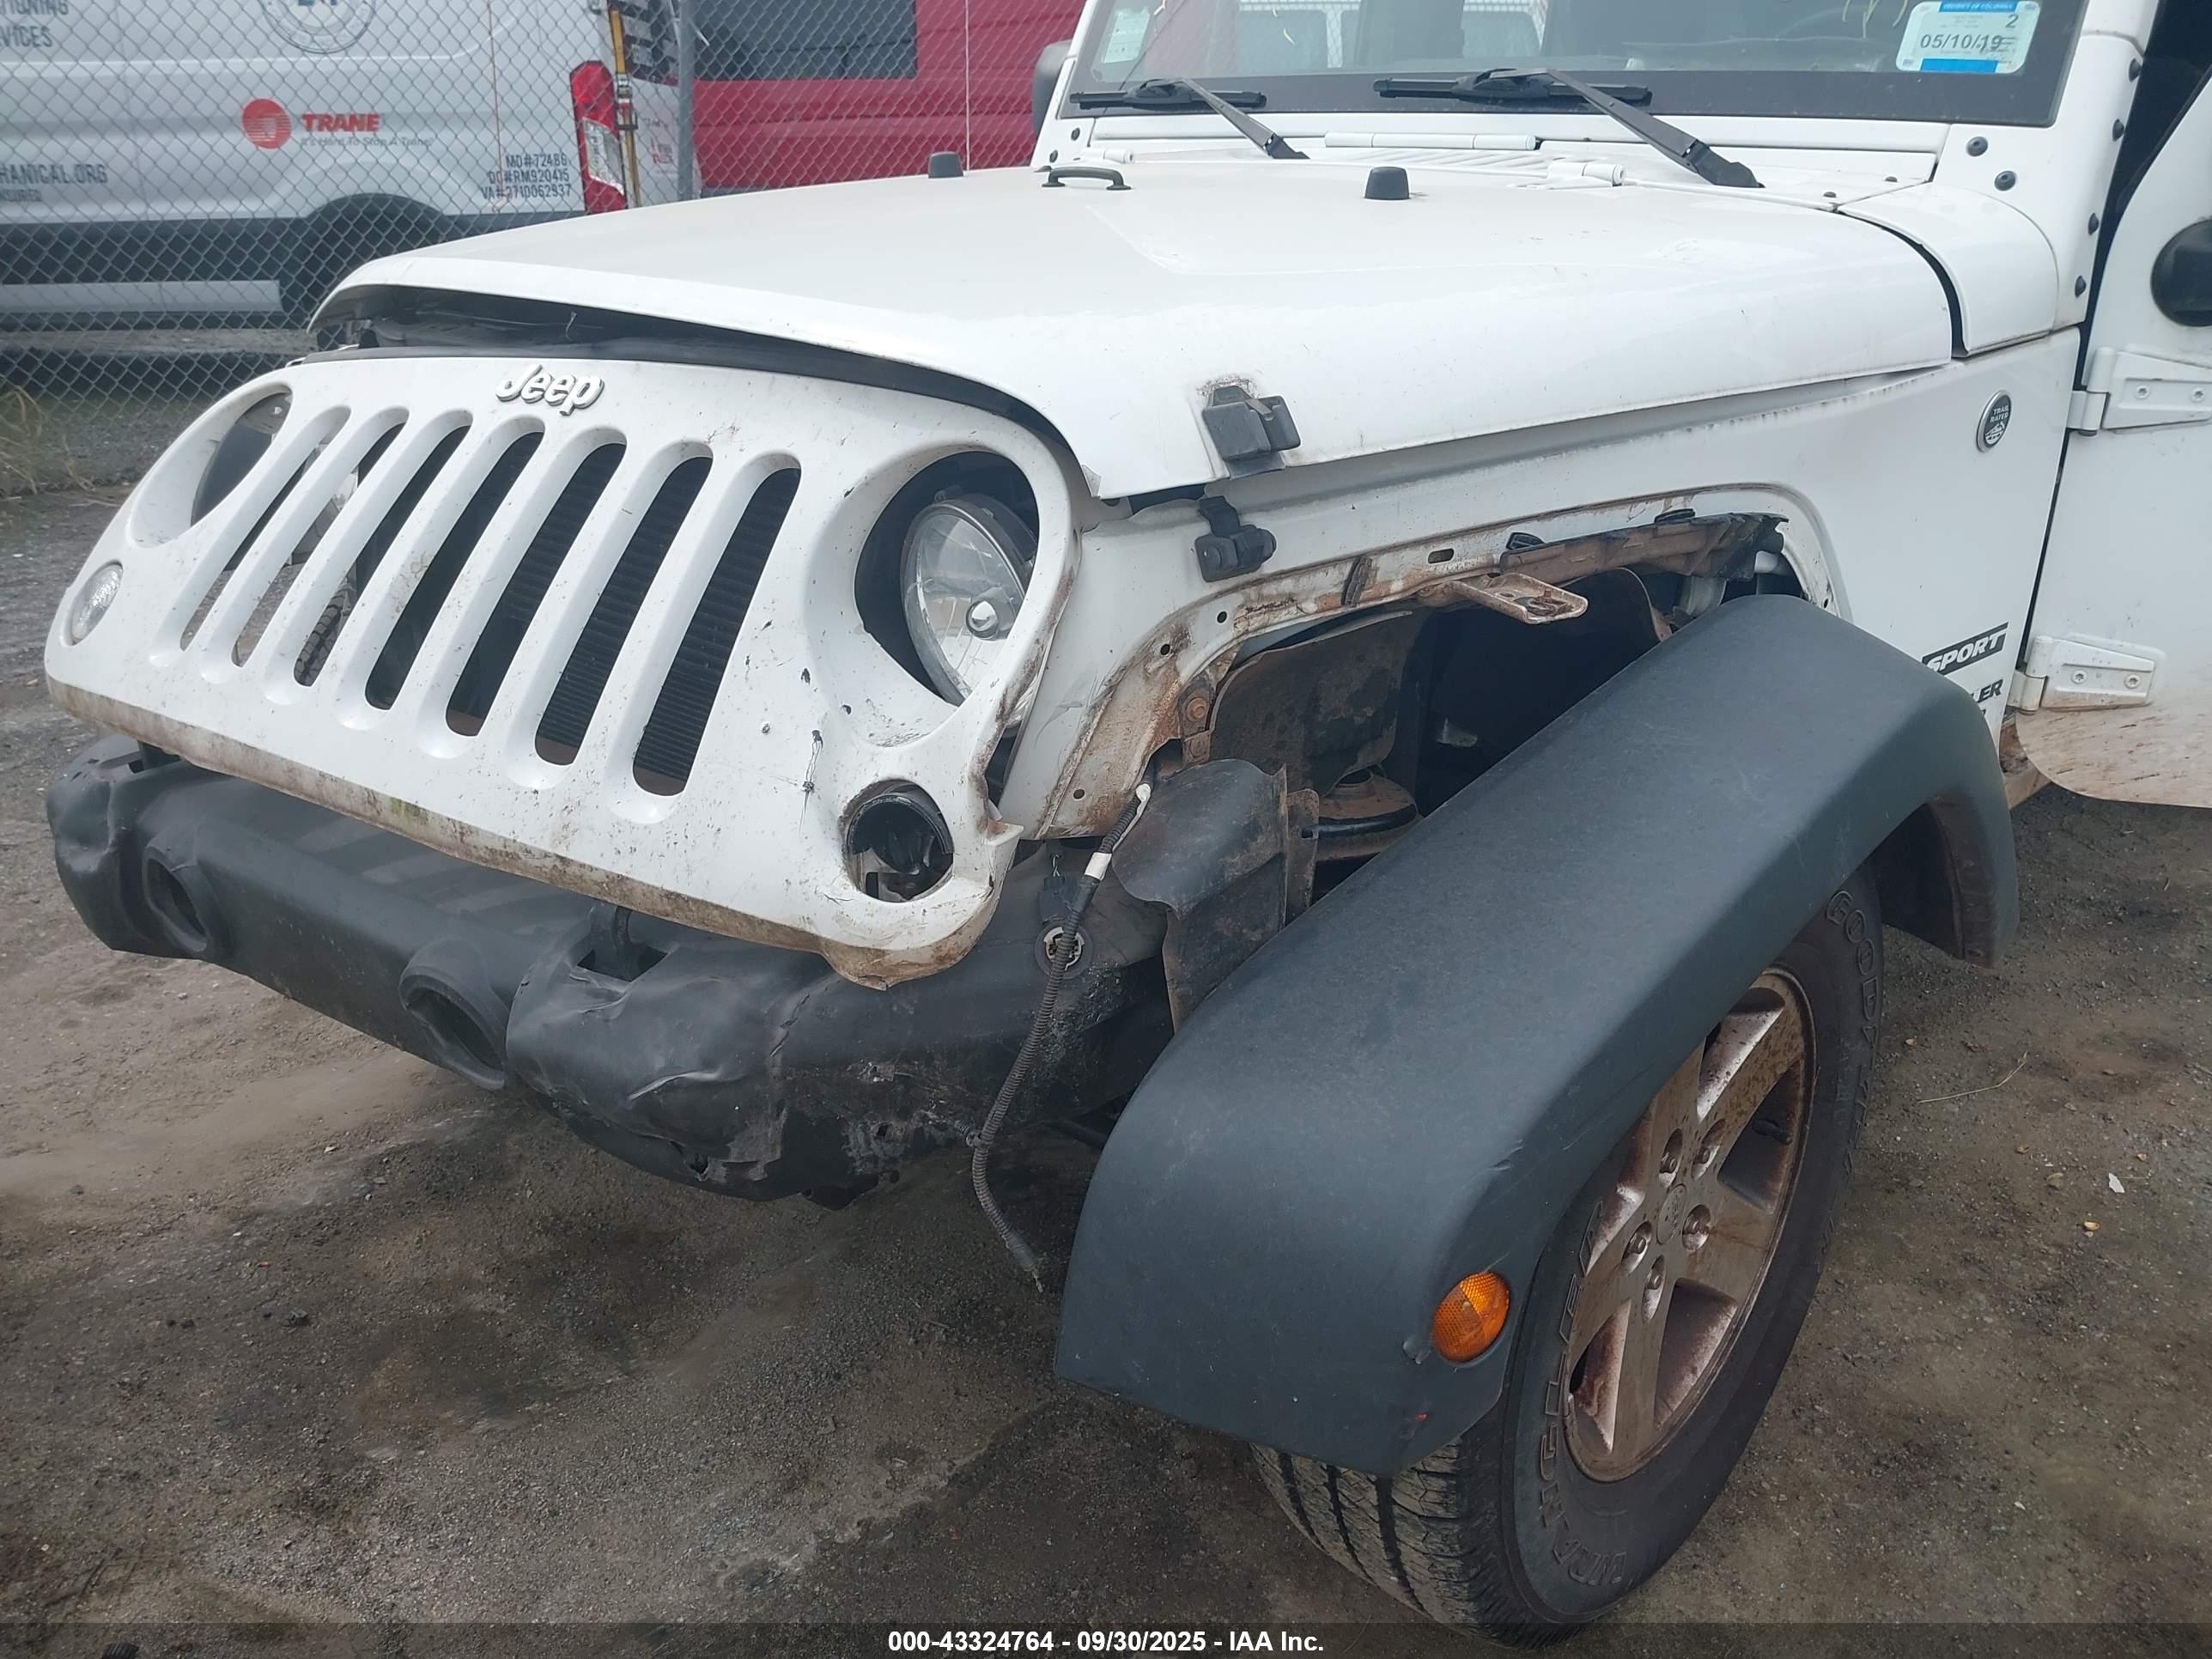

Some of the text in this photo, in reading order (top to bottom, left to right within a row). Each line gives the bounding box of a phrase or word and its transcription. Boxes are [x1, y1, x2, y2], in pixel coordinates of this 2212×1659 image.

[2005, 14, 2020, 28] 2
[1919, 33, 2003, 52] 05/10/19
[301, 113, 380, 132] TRANE
[495, 364, 605, 416] Jeep
[1926, 630, 2007, 673] SPORT
